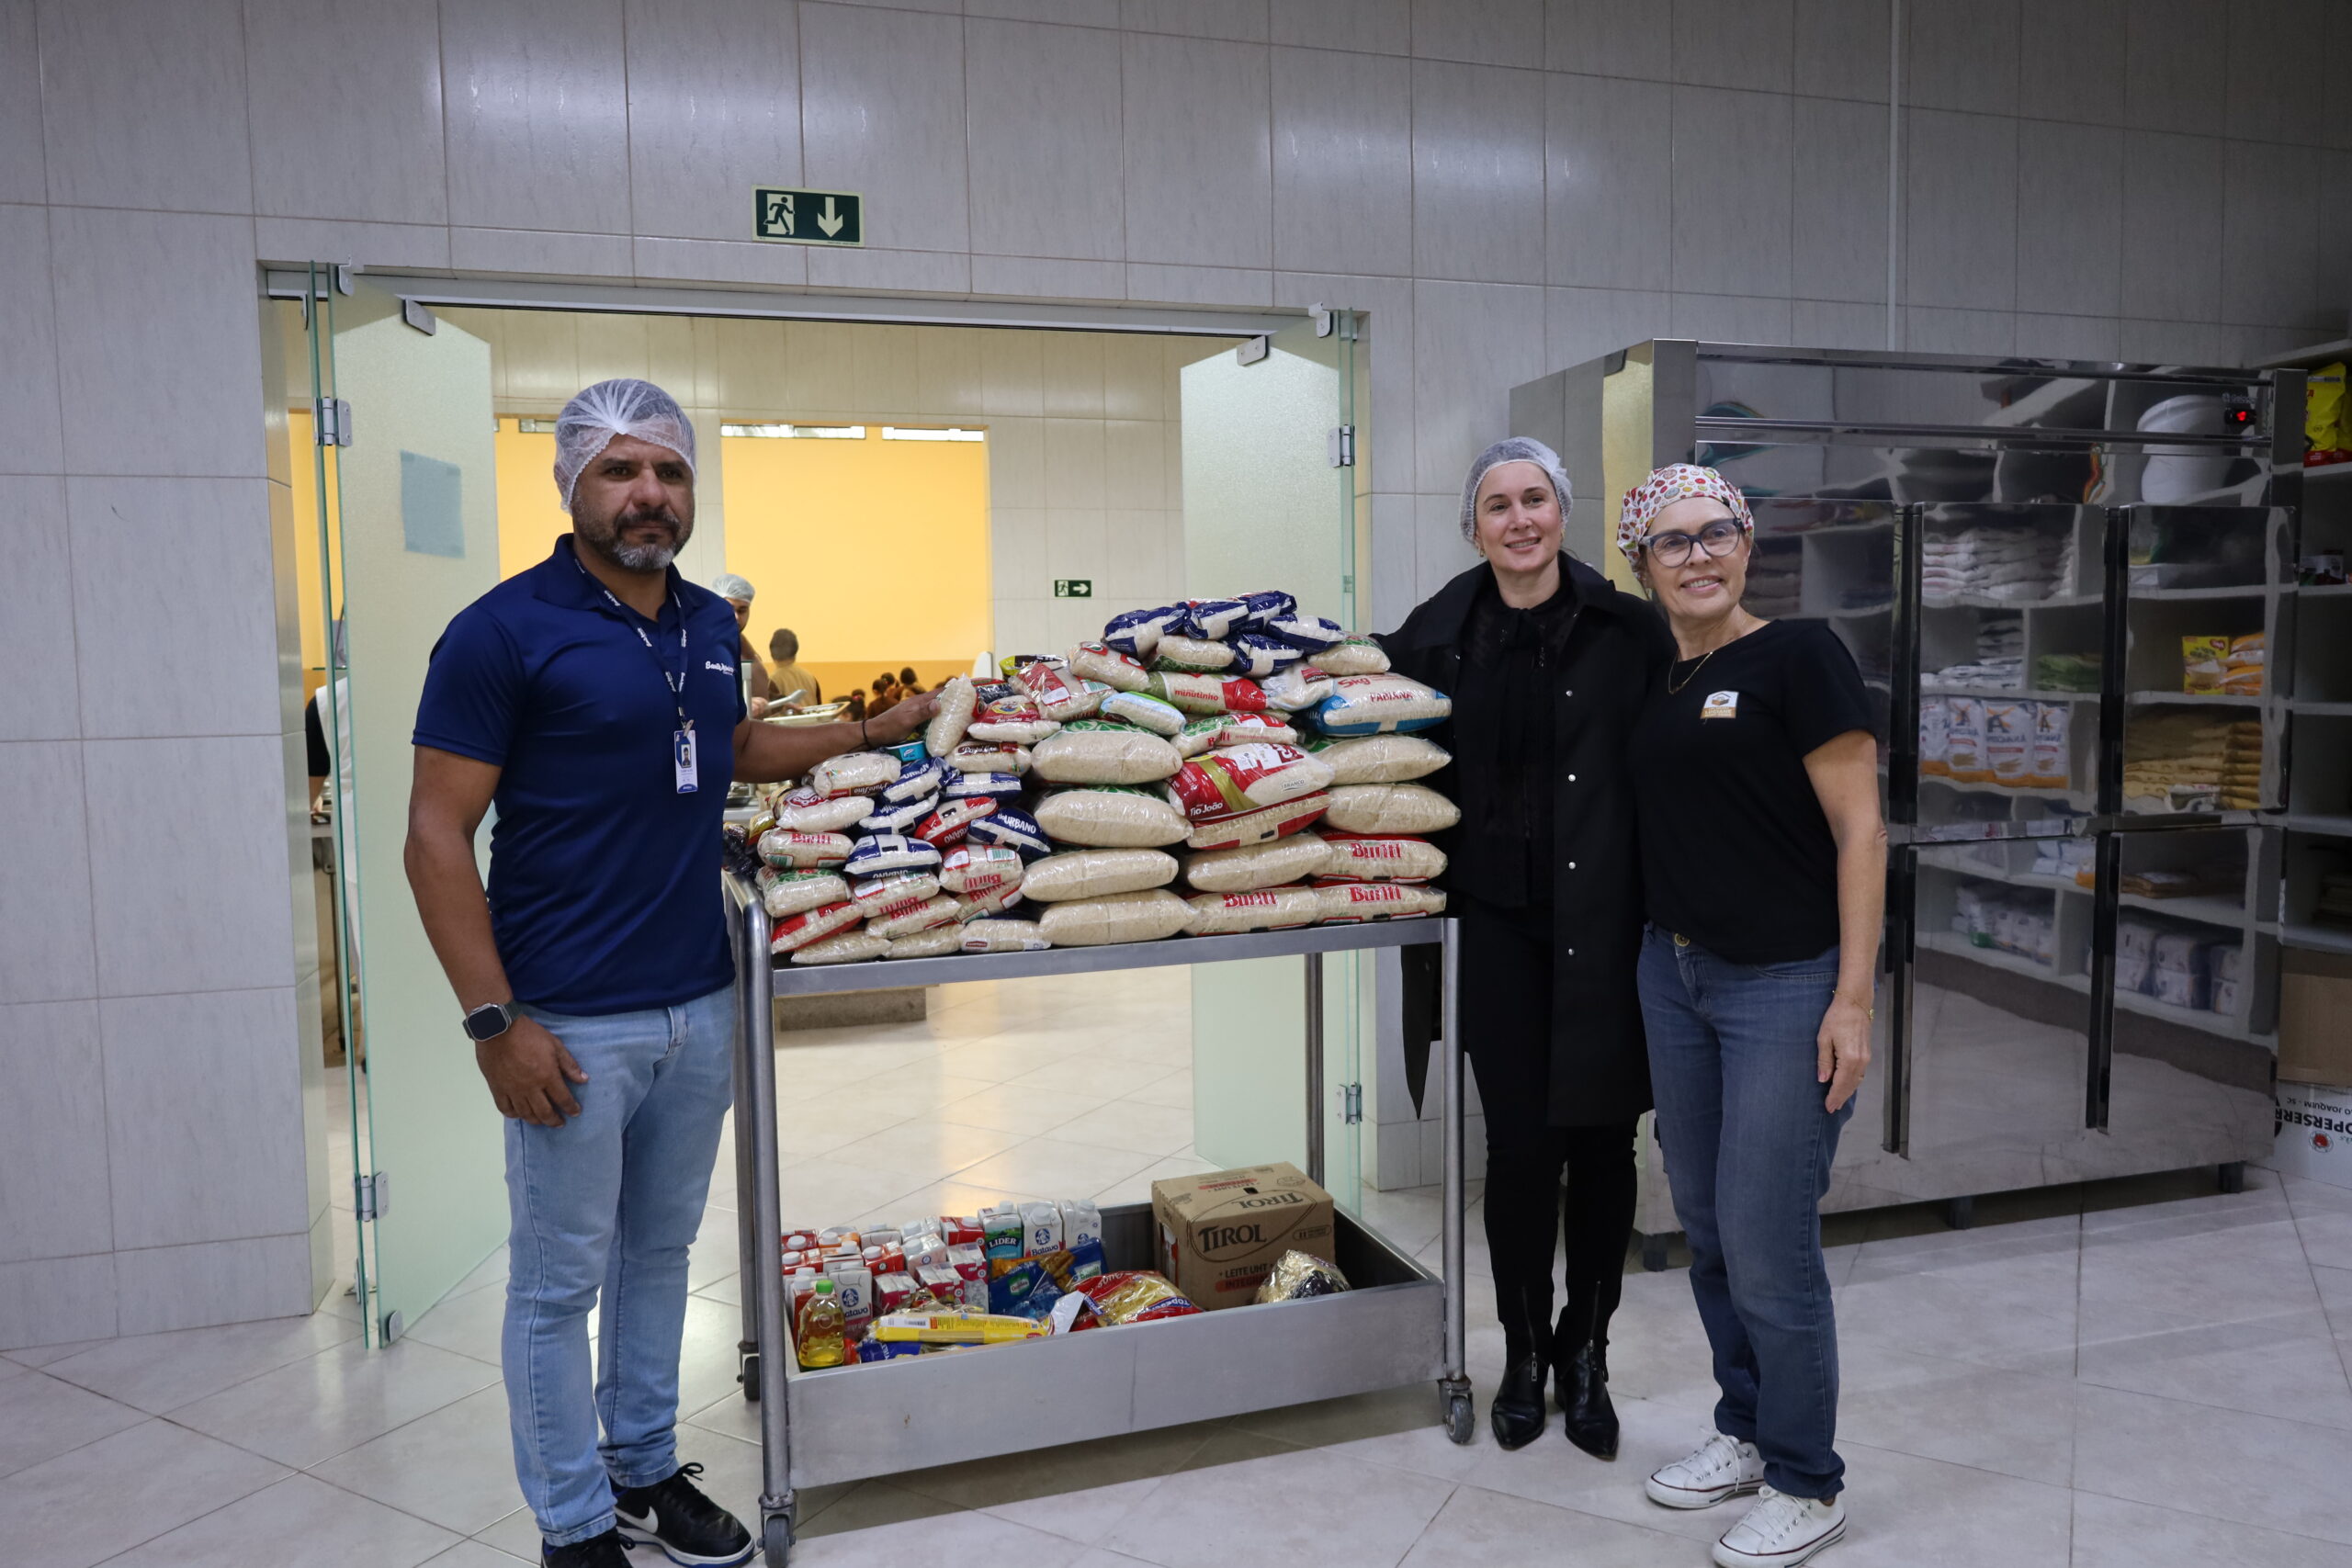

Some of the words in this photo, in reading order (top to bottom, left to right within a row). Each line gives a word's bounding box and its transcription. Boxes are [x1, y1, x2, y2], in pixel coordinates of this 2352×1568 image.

[1175, 690, 1219, 701] minutinho
[1370, 692, 1413, 703] FABIANA
[1190, 807, 1201, 817] Tio
[1202, 802, 1224, 814] João
[1004, 817, 1037, 835] URBANO
[944, 826, 969, 844] RBANO
[1351, 842, 1401, 859] Buriti
[1223, 890, 1277, 908] Buriti
[1349, 886, 1402, 902] Buriti
[2286, 1097, 2297, 1105] SC
[2304, 1100, 2342, 1113] JOAQUIM
[1232, 1192, 1304, 1210] TIROL
[989, 1236, 1017, 1248] LIDER
[1198, 1224, 1267, 1252] TIROL
[1031, 1245, 1059, 1257] Batavo
[1225, 1267, 1249, 1279] LEITE
[1250, 1263, 1268, 1274] UHT
[844, 1307, 868, 1317] atavo
